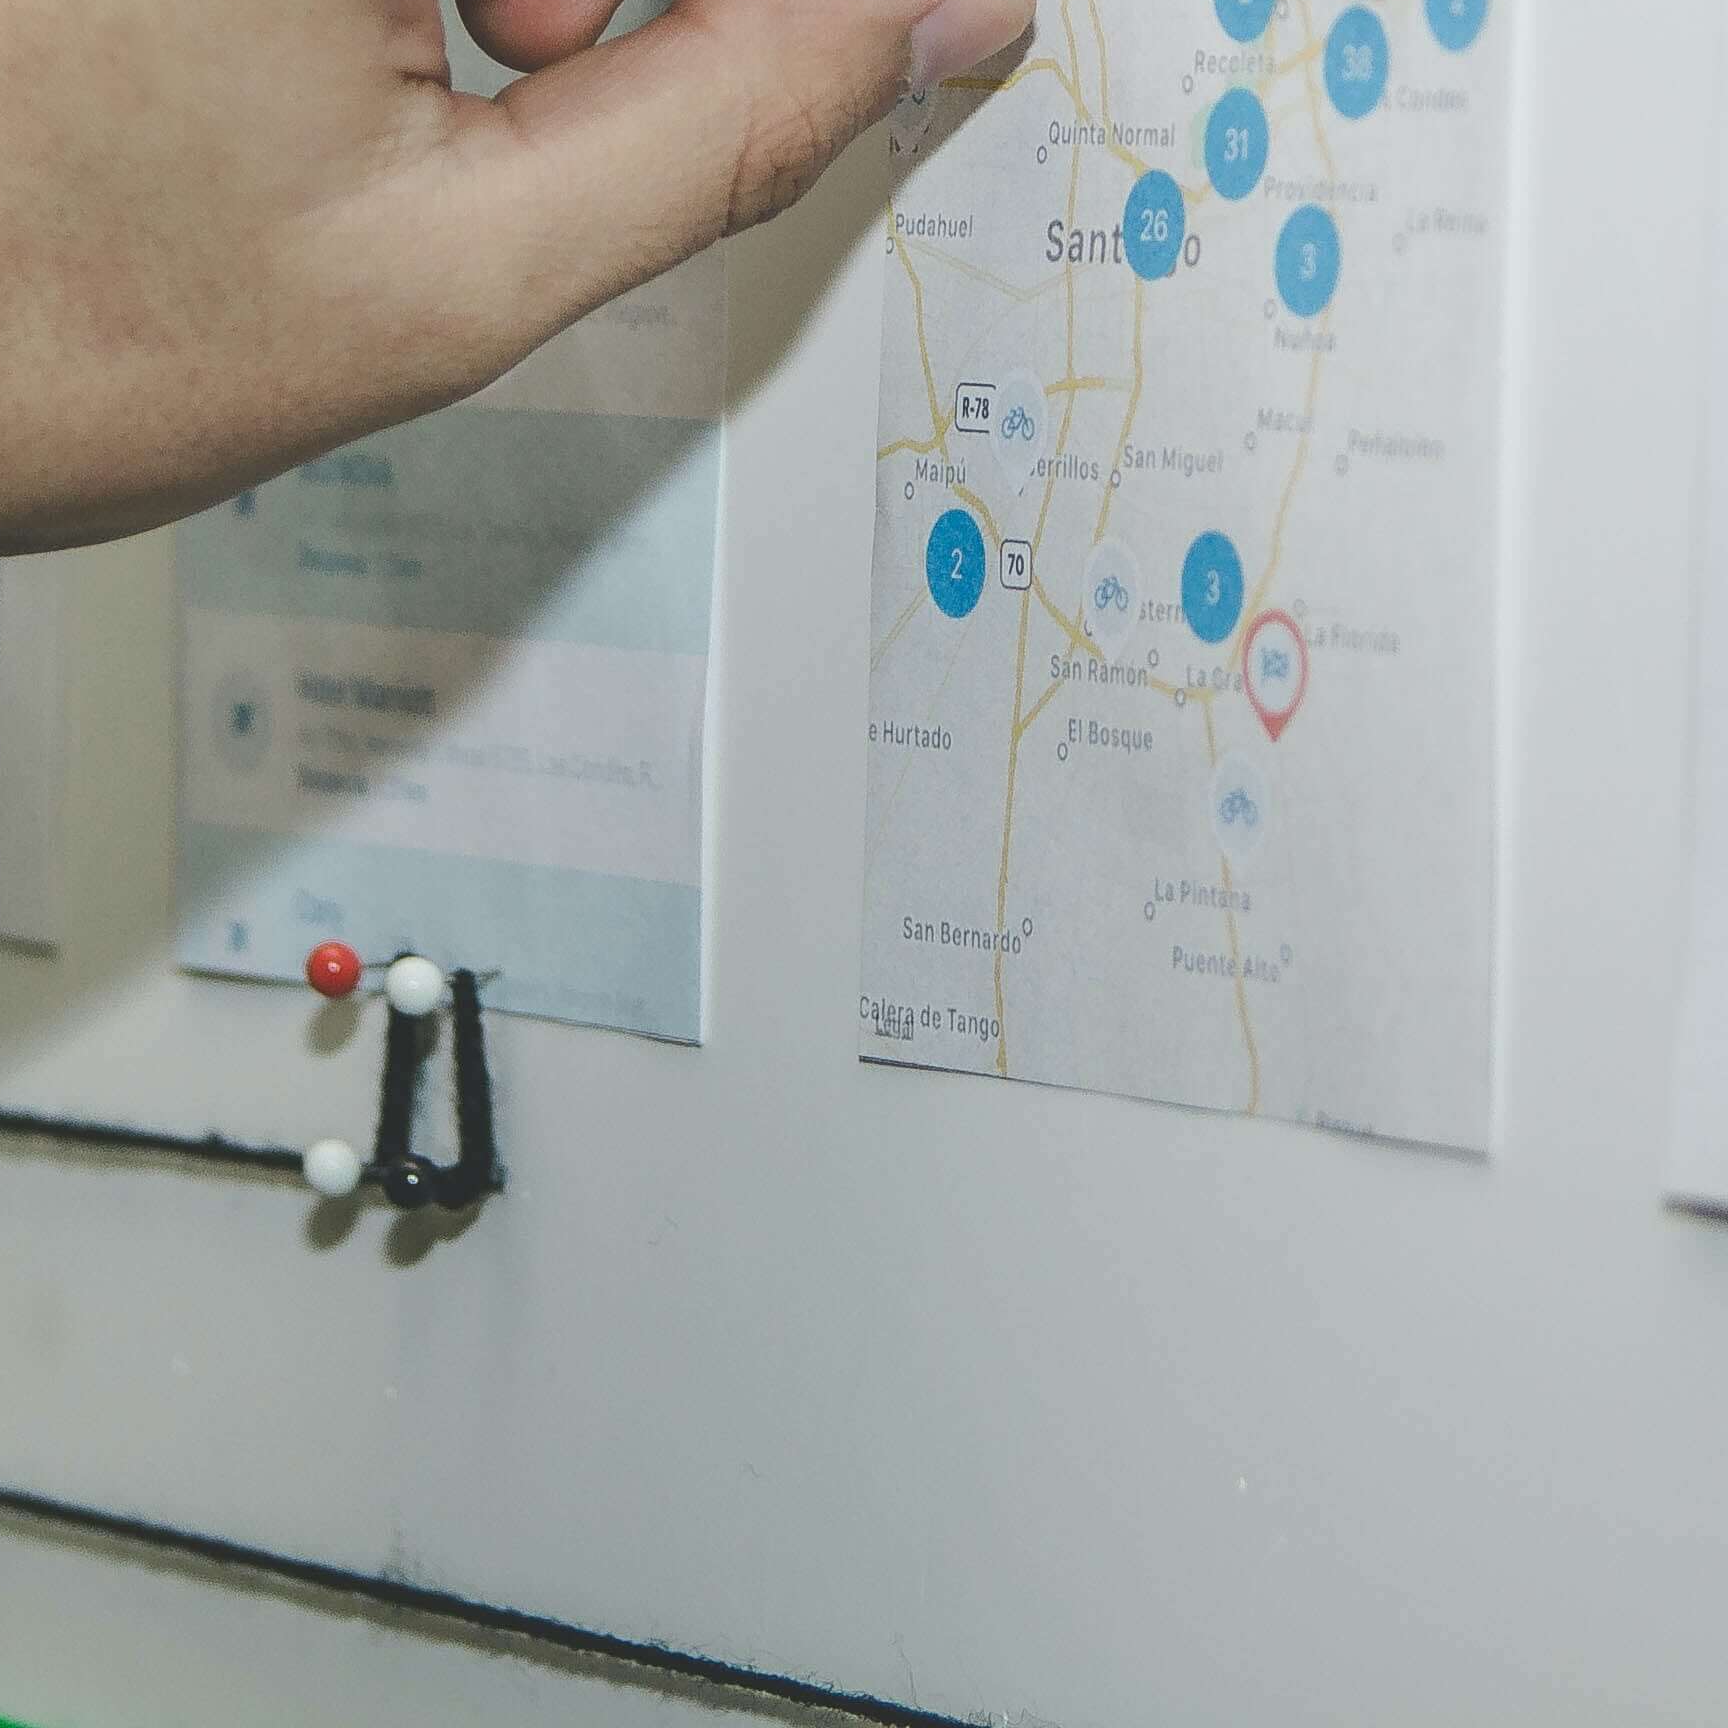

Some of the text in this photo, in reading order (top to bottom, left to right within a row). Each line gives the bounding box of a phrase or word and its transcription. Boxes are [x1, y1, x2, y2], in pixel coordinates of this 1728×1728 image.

[1049, 121, 1175, 148] Quinta Normal
[1224, 128, 1250, 162] 31
[895, 213, 973, 239] Pudahuel
[1139, 209, 1169, 242] 26
[1046, 219, 1200, 268] Santo
[1300, 241, 1317, 281] 3
[962, 396, 990, 420] R-78
[915, 458, 966, 487] Maipú
[1030, 455, 1098, 481] errillos
[1123, 445, 1224, 476] San Miguel
[951, 548, 963, 580] 2
[1007, 554, 1024, 576] 70
[1050, 654, 1082, 680] San
[883, 721, 952, 751] Hurtado
[1068, 719, 1153, 755] El Bosque
[1154, 876, 1175, 903] La
[903, 916, 1021, 955] San Bernardo
[1172, 944, 1237, 978] Puente
[859, 995, 1000, 1042] Calera de Tango
